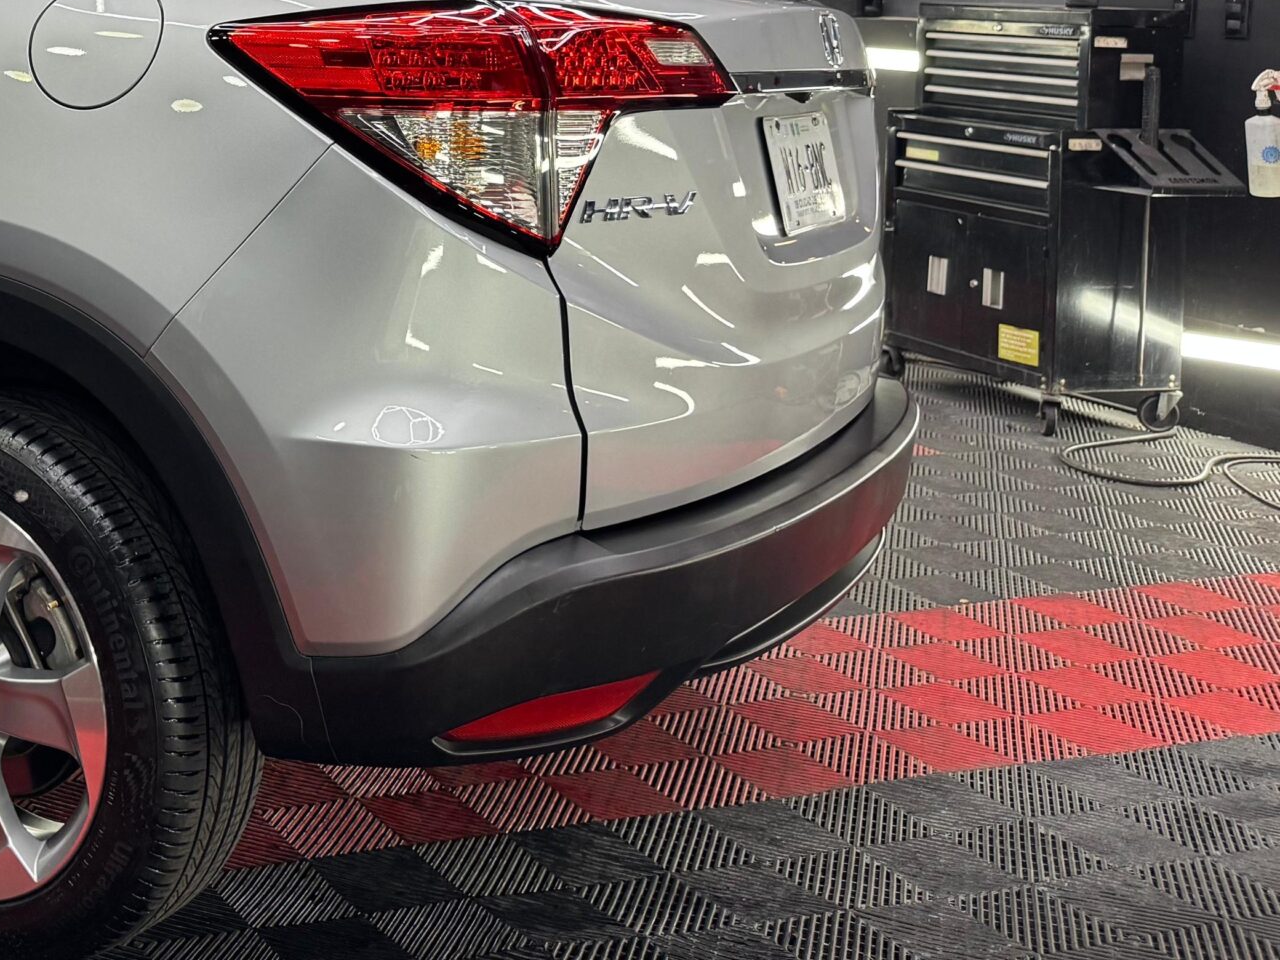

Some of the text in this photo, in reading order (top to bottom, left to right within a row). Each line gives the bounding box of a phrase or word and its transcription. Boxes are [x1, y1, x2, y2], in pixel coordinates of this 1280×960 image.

[1047, 27, 1074, 37] HUSKY
[1011, 134, 1038, 144] HUSKY
[579, 190, 698, 224] HR-V
[68, 544, 145, 710] Continental
